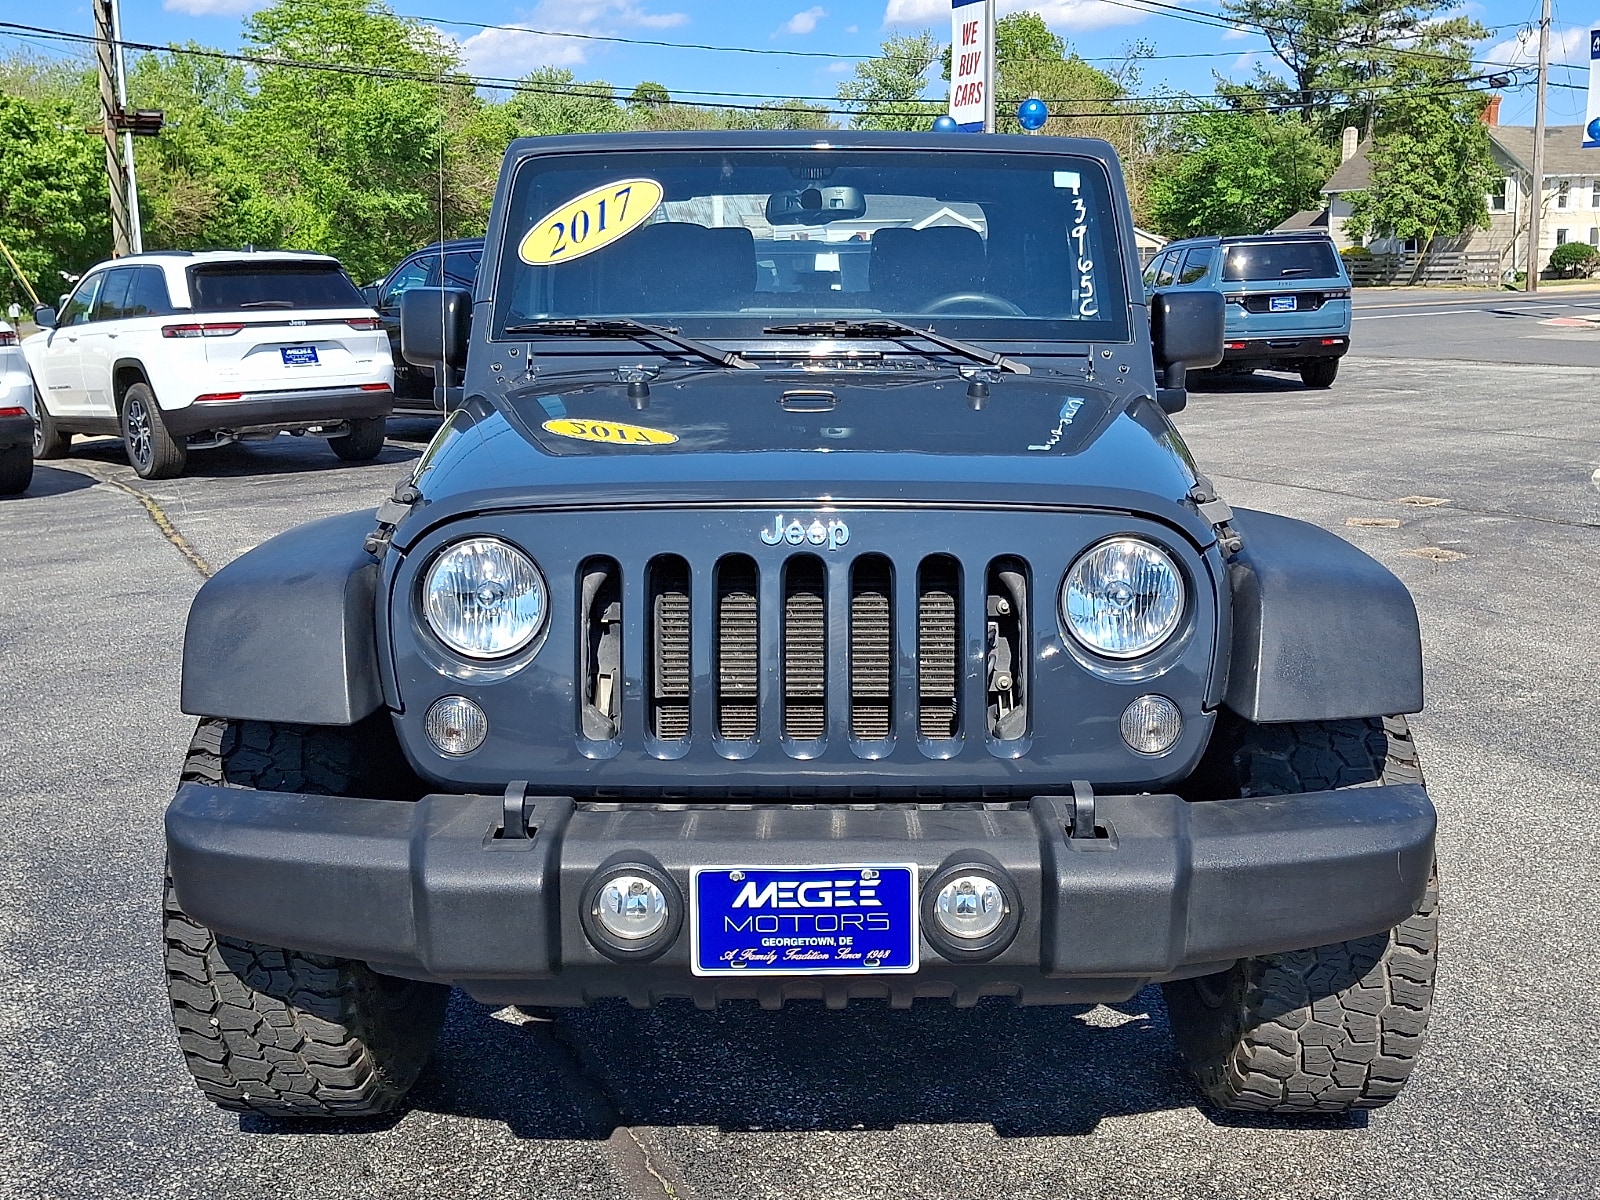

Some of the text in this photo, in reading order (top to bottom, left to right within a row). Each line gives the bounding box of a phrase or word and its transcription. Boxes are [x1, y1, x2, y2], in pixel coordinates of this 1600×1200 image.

[962, 21, 978, 46] WE
[959, 51, 981, 77] BUY
[954, 81, 983, 107] CARS
[548, 186, 631, 258] 2017
[760, 514, 850, 551] Jeep
[731, 880, 882, 909] MEGEE
[724, 913, 890, 932] MOTORS
[761, 937, 853, 947] GEORGETOWN, DE
[720, 949, 739, 960] A
[739, 948, 777, 964] Family
[782, 948, 830, 960] Tradition
[834, 947, 862, 959] Since
